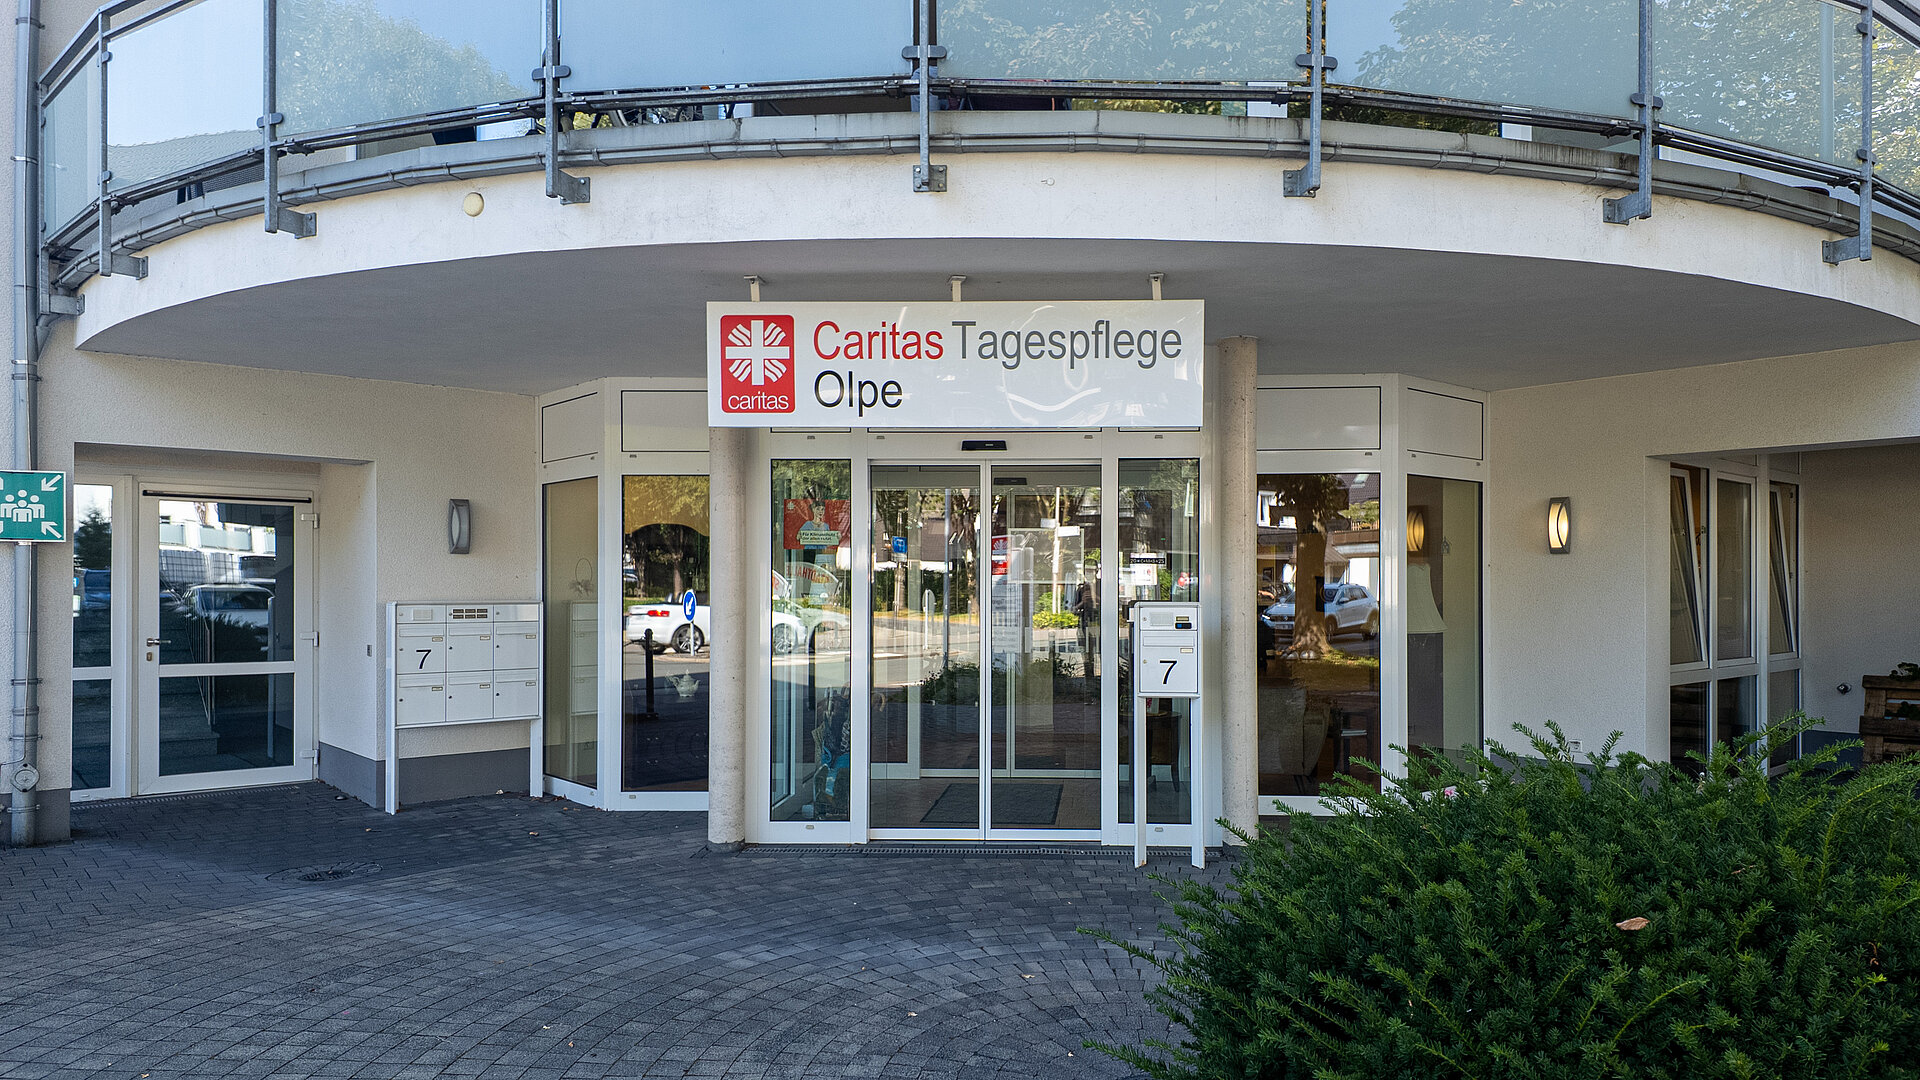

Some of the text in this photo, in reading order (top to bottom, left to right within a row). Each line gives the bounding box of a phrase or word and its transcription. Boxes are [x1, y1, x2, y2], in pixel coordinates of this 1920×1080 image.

[813, 319, 1182, 370] Caritas Tagespflege
[728, 390, 790, 411] caritas
[814, 370, 903, 417] Olpe
[416, 649, 432, 671] 7
[1160, 660, 1178, 685] 7
